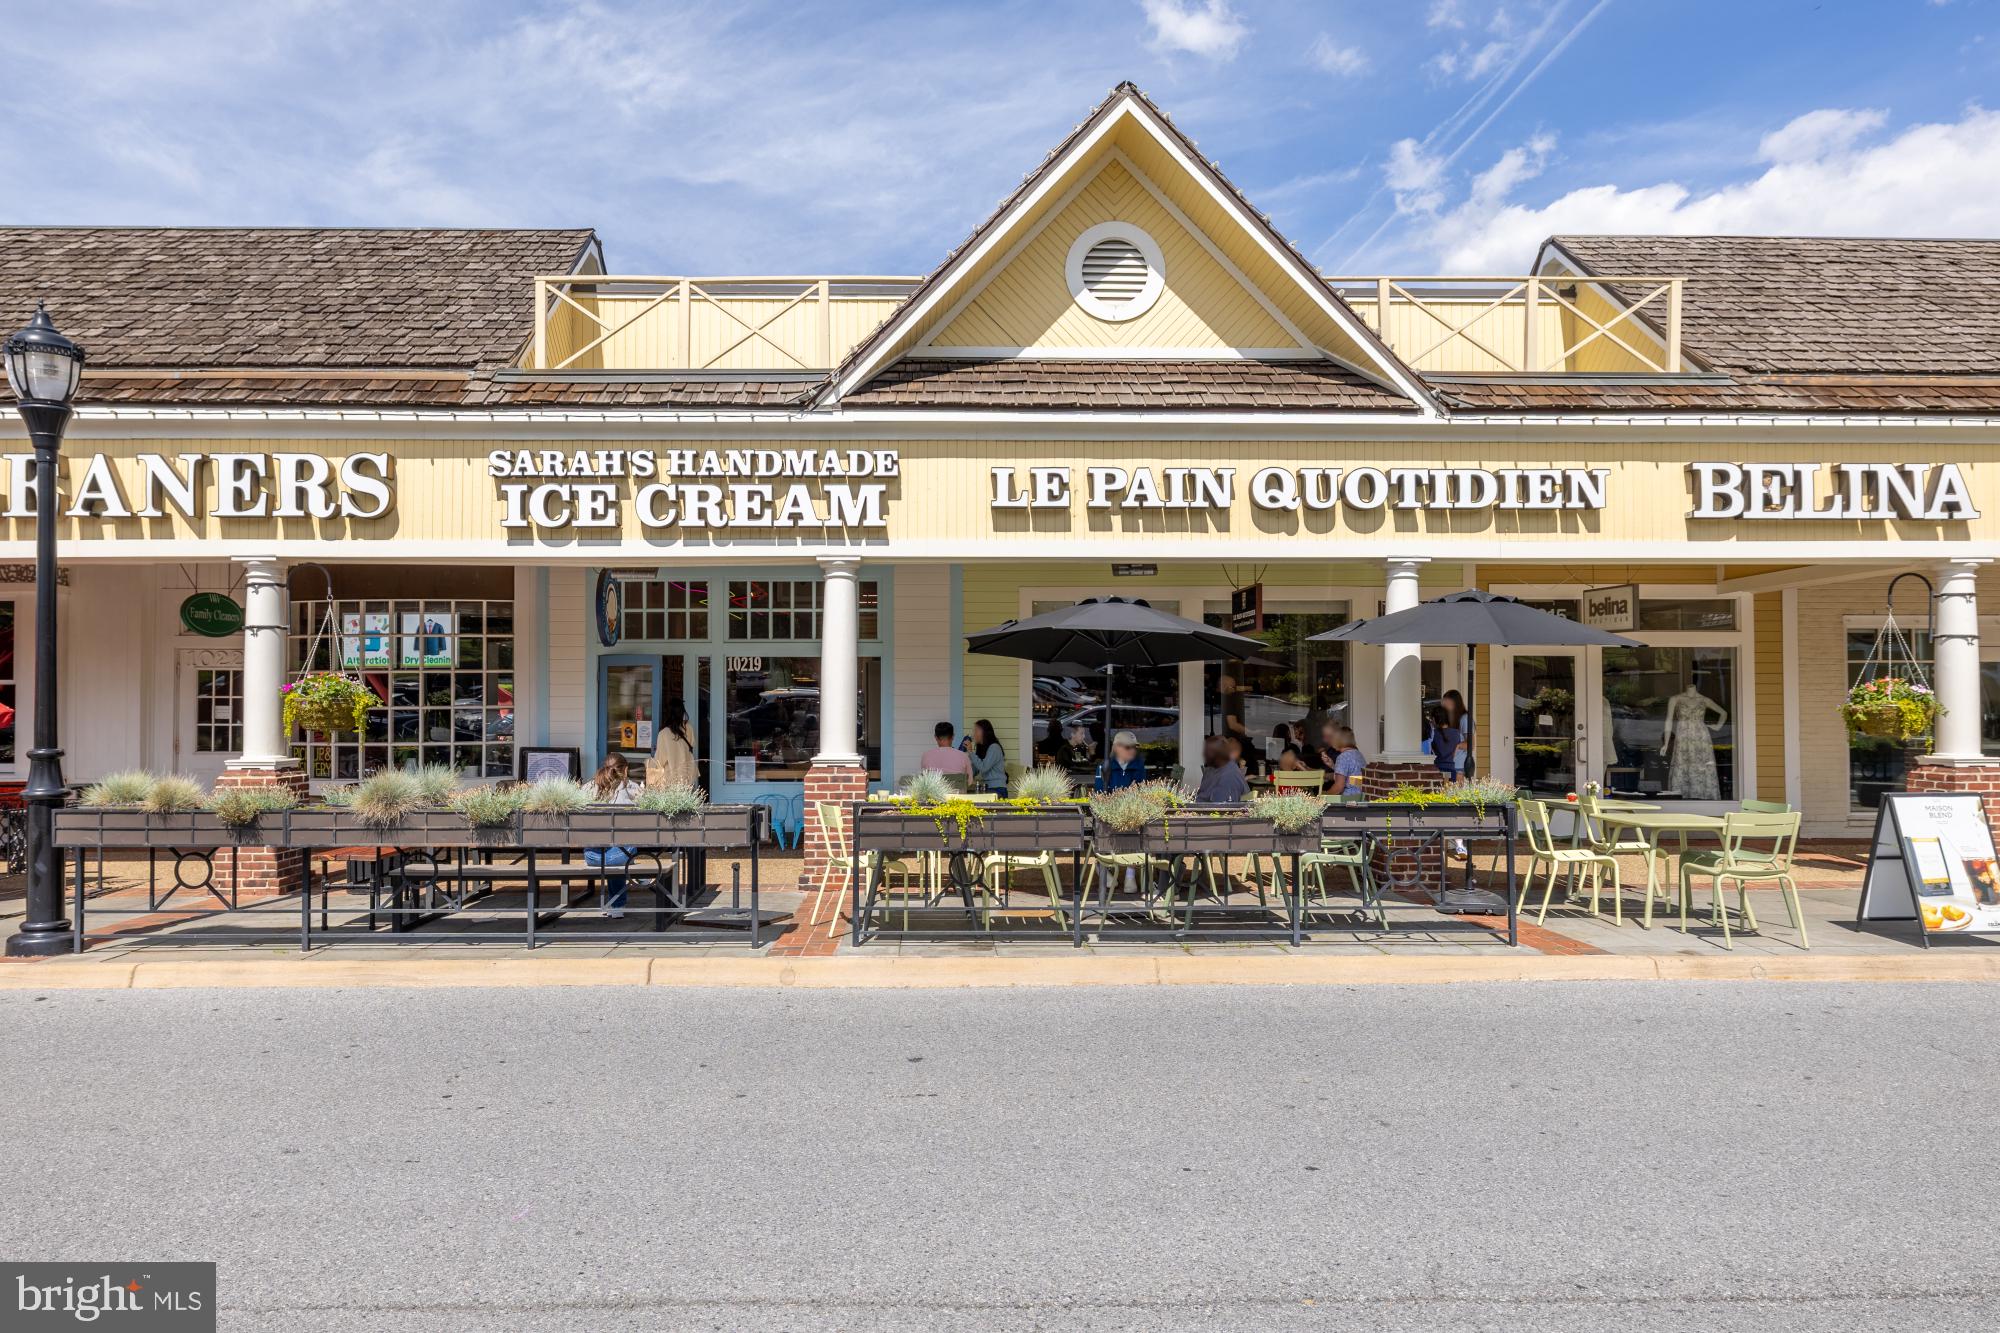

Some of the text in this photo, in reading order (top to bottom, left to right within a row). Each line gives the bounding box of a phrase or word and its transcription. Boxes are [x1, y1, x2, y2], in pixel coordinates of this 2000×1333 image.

[487, 449, 899, 478] SARAH'S HANDMADE
[990, 466, 1611, 512] LE PAIN QUOTIDIEN
[1690, 462, 1981, 519] BELINA
[500, 483, 887, 529] ICE CREAM
[190, 606, 240, 622] Family Cleaners
[1588, 596, 1628, 617] belina
[404, 656, 452, 664] Dry Cleanin
[727, 656, 762, 672] 10219
